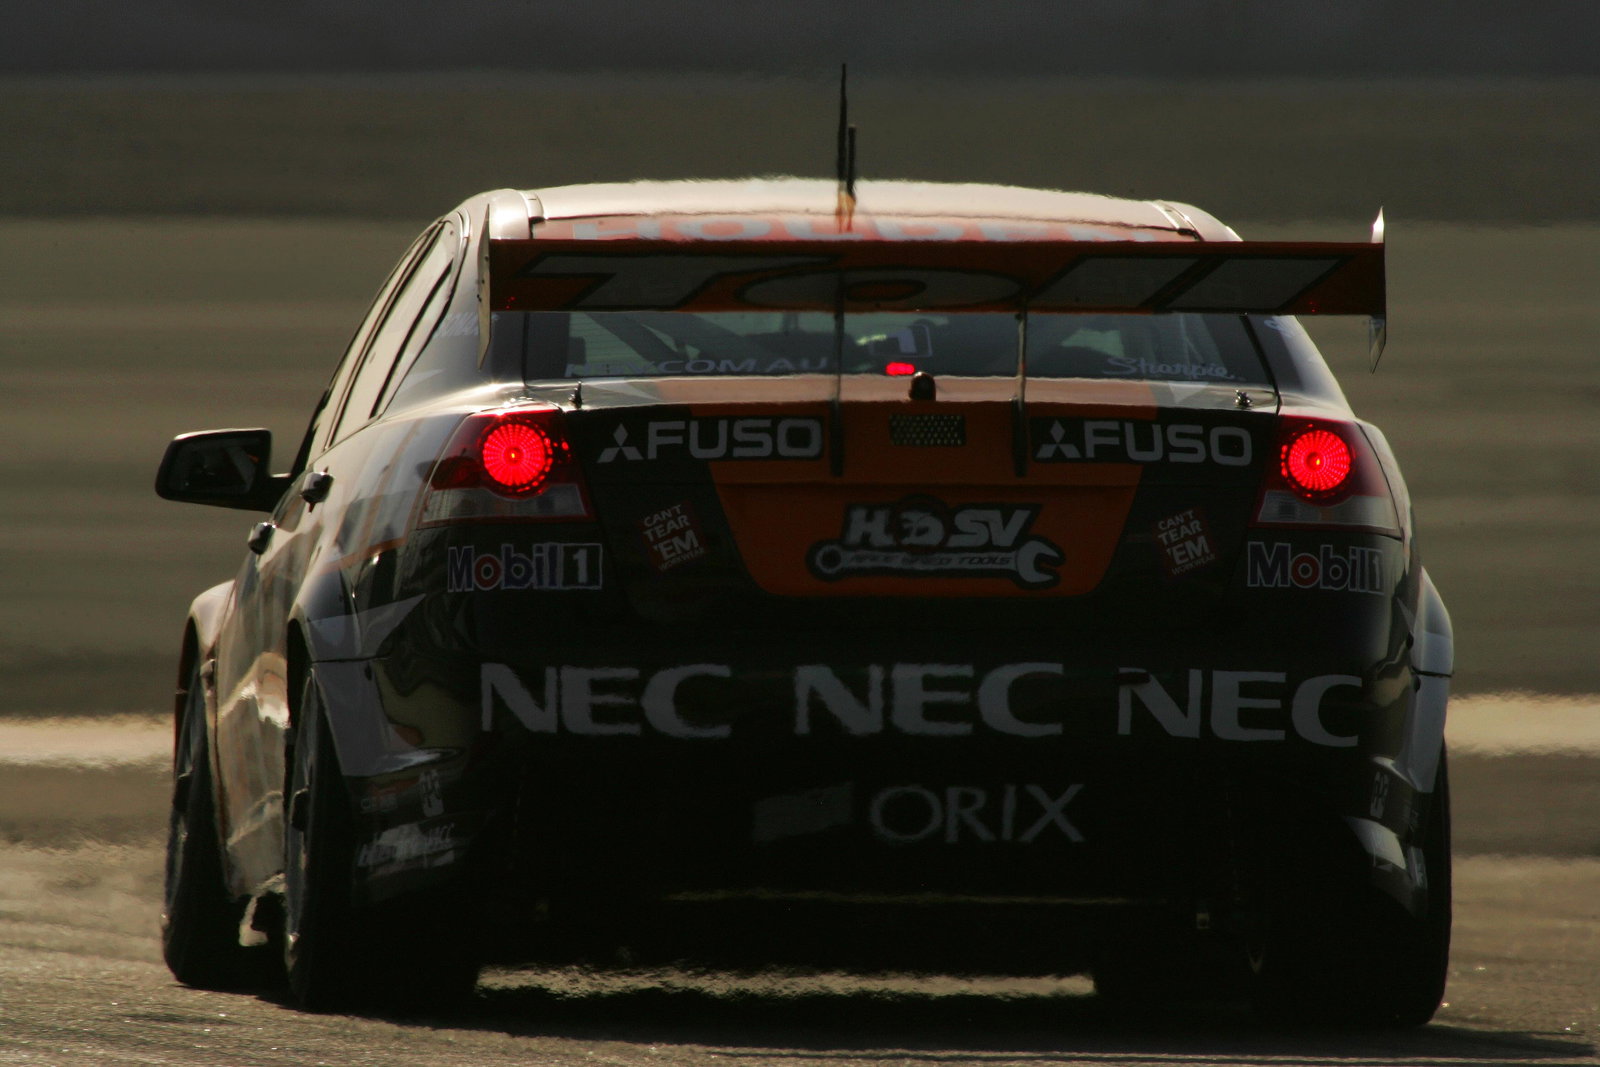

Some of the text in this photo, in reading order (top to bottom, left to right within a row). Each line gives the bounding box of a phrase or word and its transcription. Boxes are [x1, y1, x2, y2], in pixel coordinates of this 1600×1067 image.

[647, 418, 822, 460] FUSO
[1084, 420, 1252, 466] FUSO
[642, 515, 690, 542] TEAR
[1157, 520, 1202, 545] TEAR
[447, 542, 560, 592] Mobil
[1247, 541, 1368, 593] Mobil
[480, 662, 732, 739] NEC
[793, 662, 1064, 737] NEC
[1117, 667, 1363, 748] NEC
[868, 783, 1086, 845] ORIX
